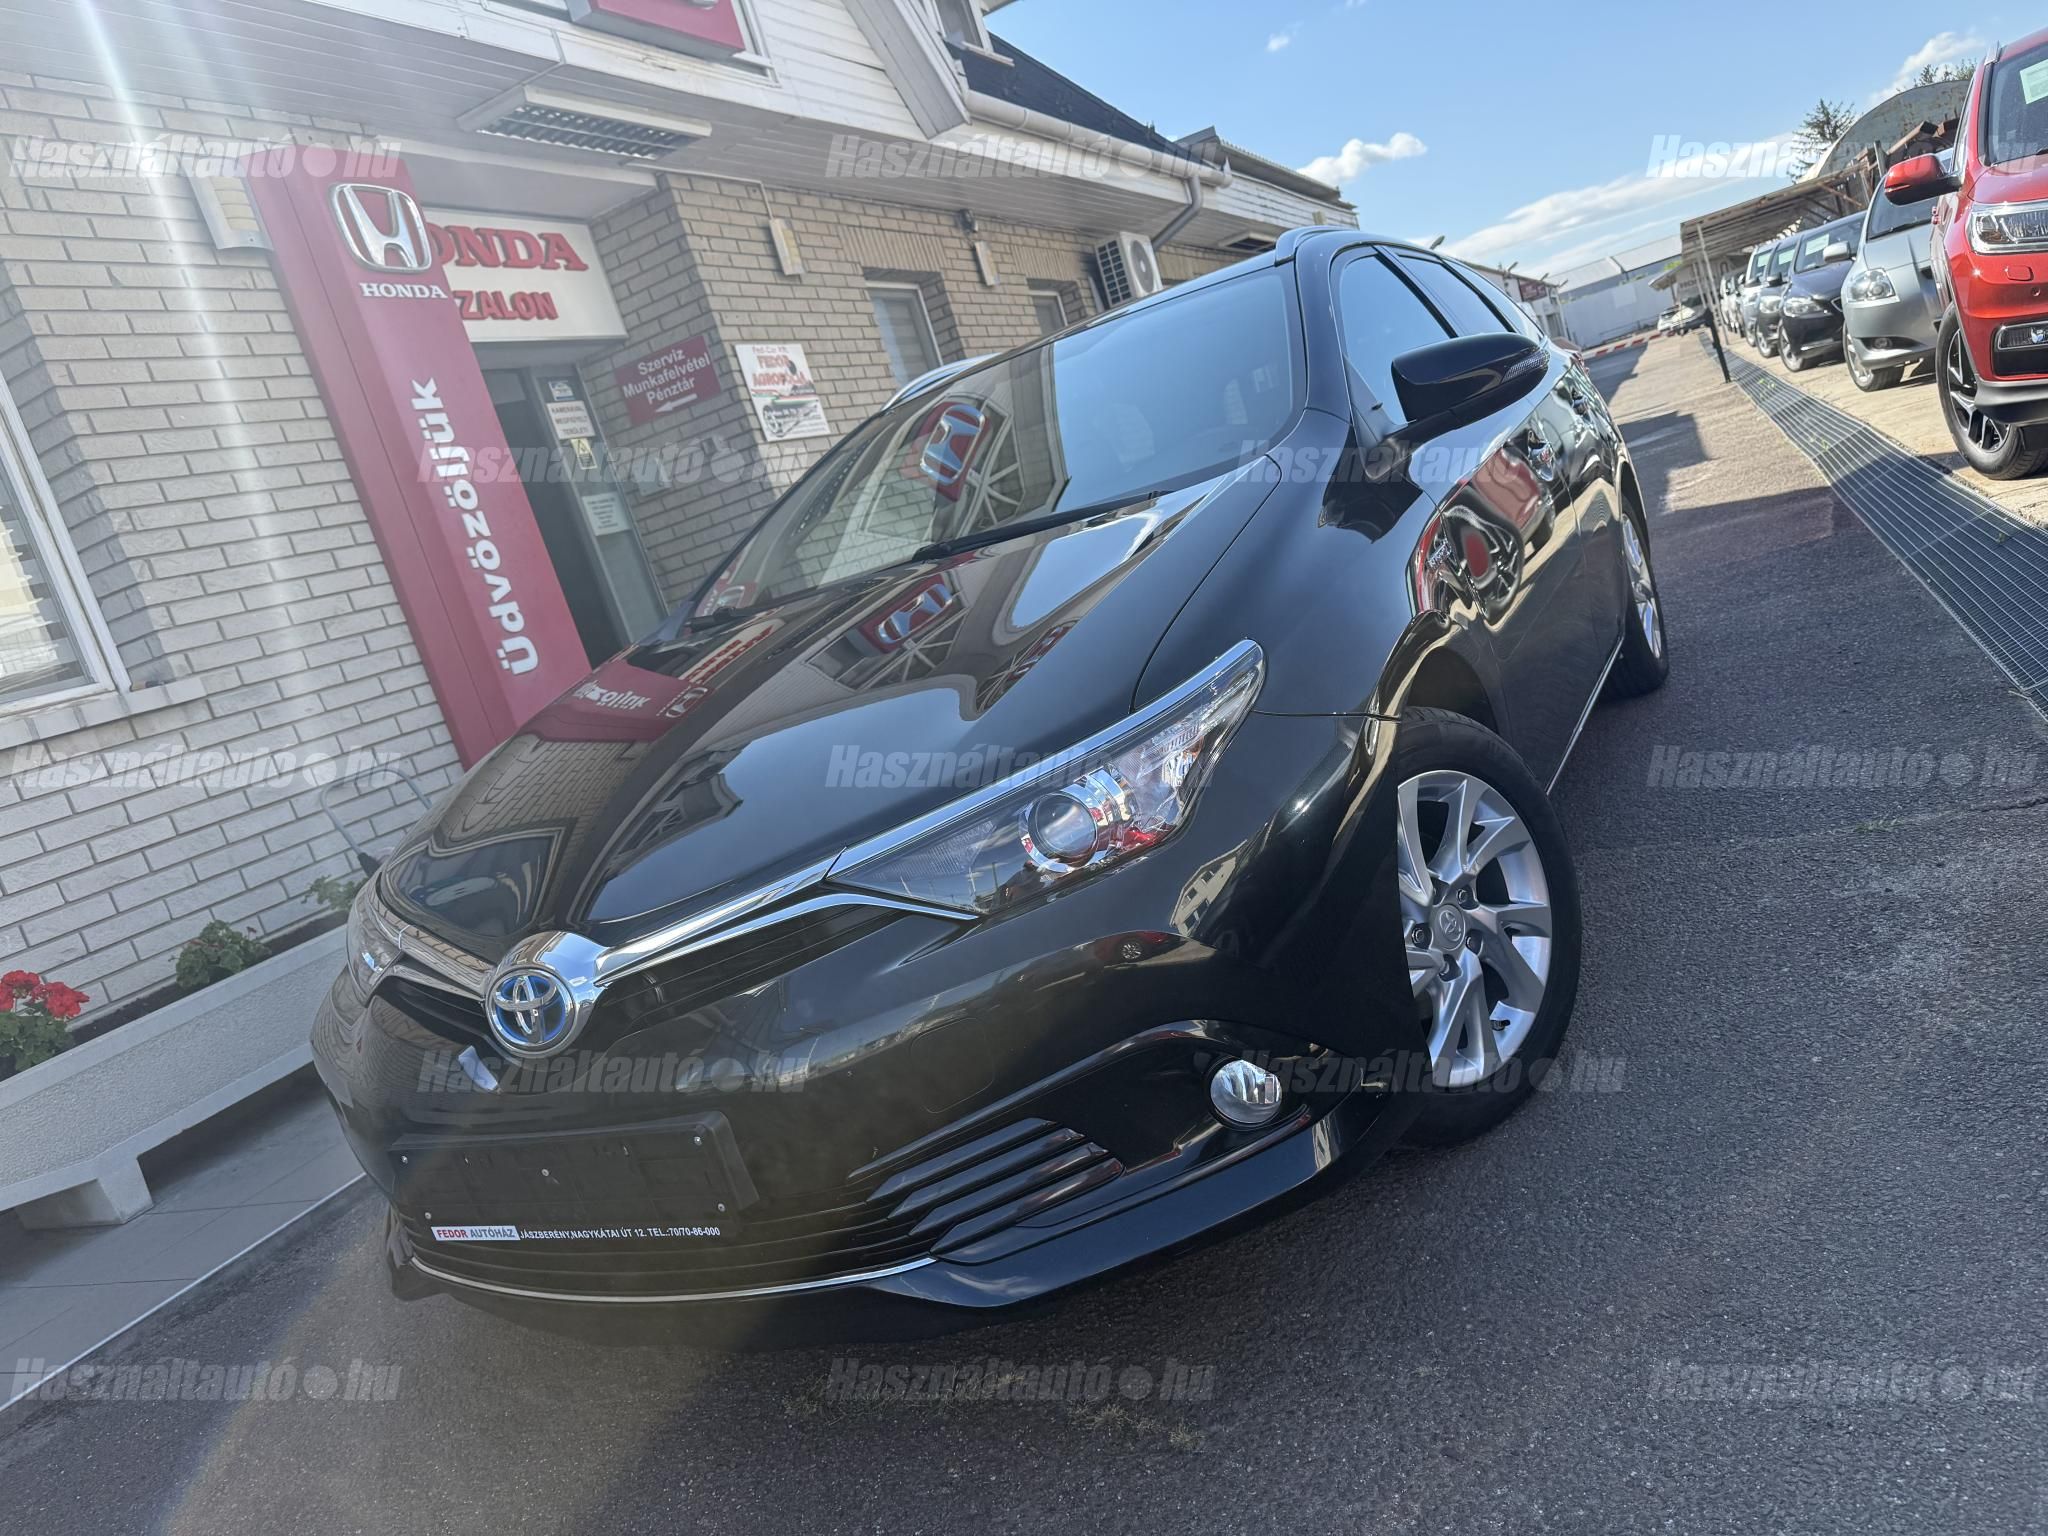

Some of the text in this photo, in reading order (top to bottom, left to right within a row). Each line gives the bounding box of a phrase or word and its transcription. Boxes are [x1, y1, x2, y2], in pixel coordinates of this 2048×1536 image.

[359, 282, 449, 299] HONDA
[622, 352, 711, 398] Munkafelvétel
[638, 349, 686, 375] Szerviz
[646, 377, 695, 405] Pénztár
[411, 377, 540, 676] Üdvözöljük
[436, 1228, 469, 1239] FEDOR
[469, 1226, 516, 1239] AUTÓHÁZ
[621, 1226, 633, 1238] ÚT
[634, 1228, 647, 1238] 12.
